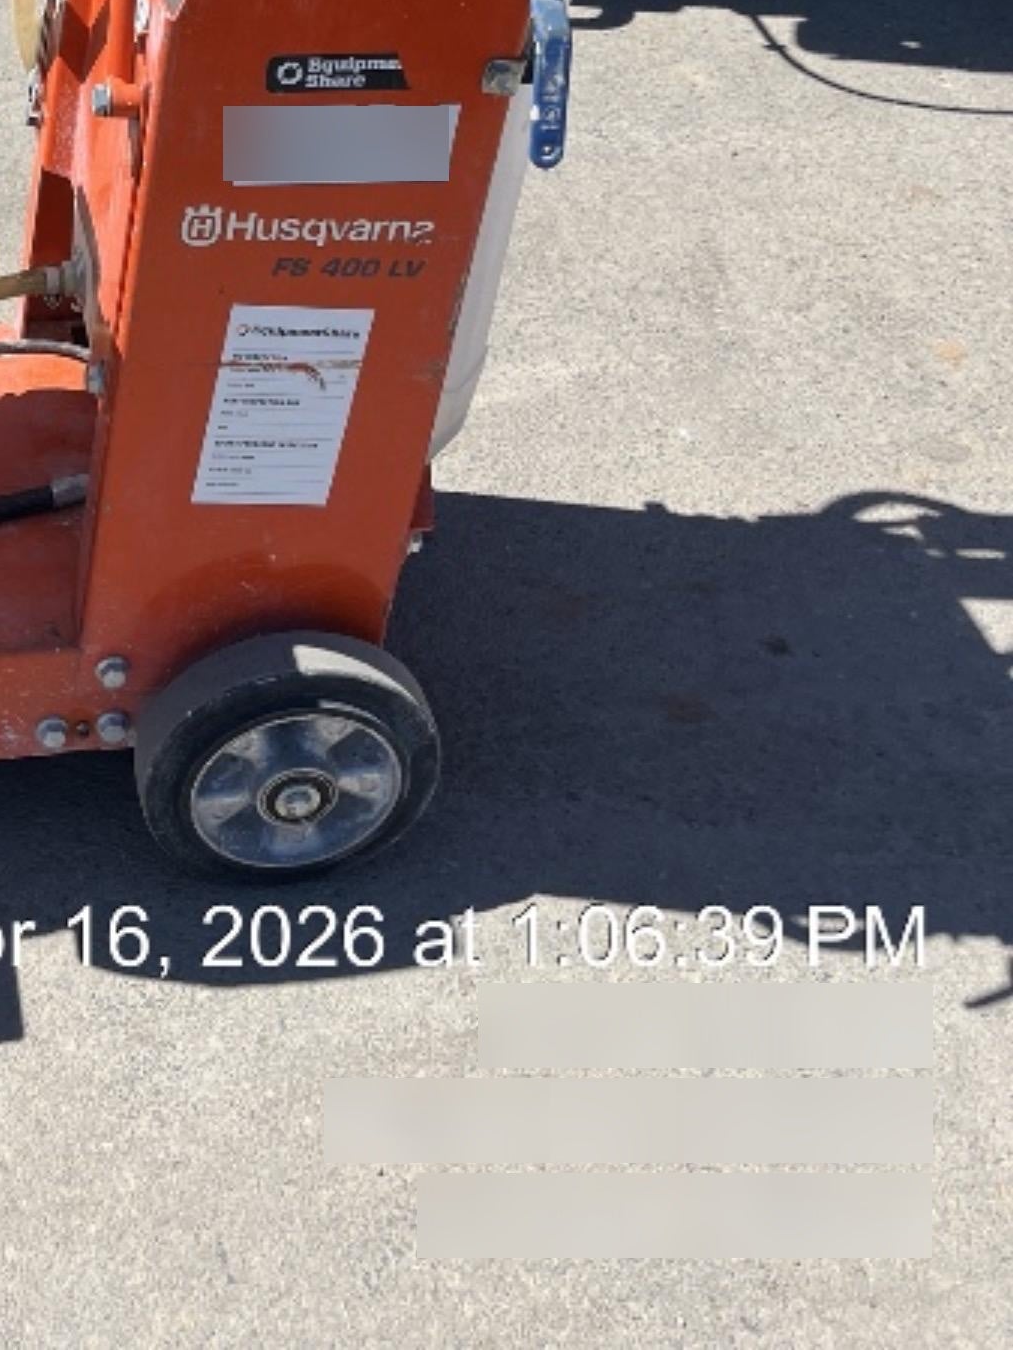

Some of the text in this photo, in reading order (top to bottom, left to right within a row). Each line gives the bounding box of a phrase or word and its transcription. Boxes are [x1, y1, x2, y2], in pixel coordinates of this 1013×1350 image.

[305, 74, 366, 88] Share
[272, 257, 426, 278] FS 400 LV
